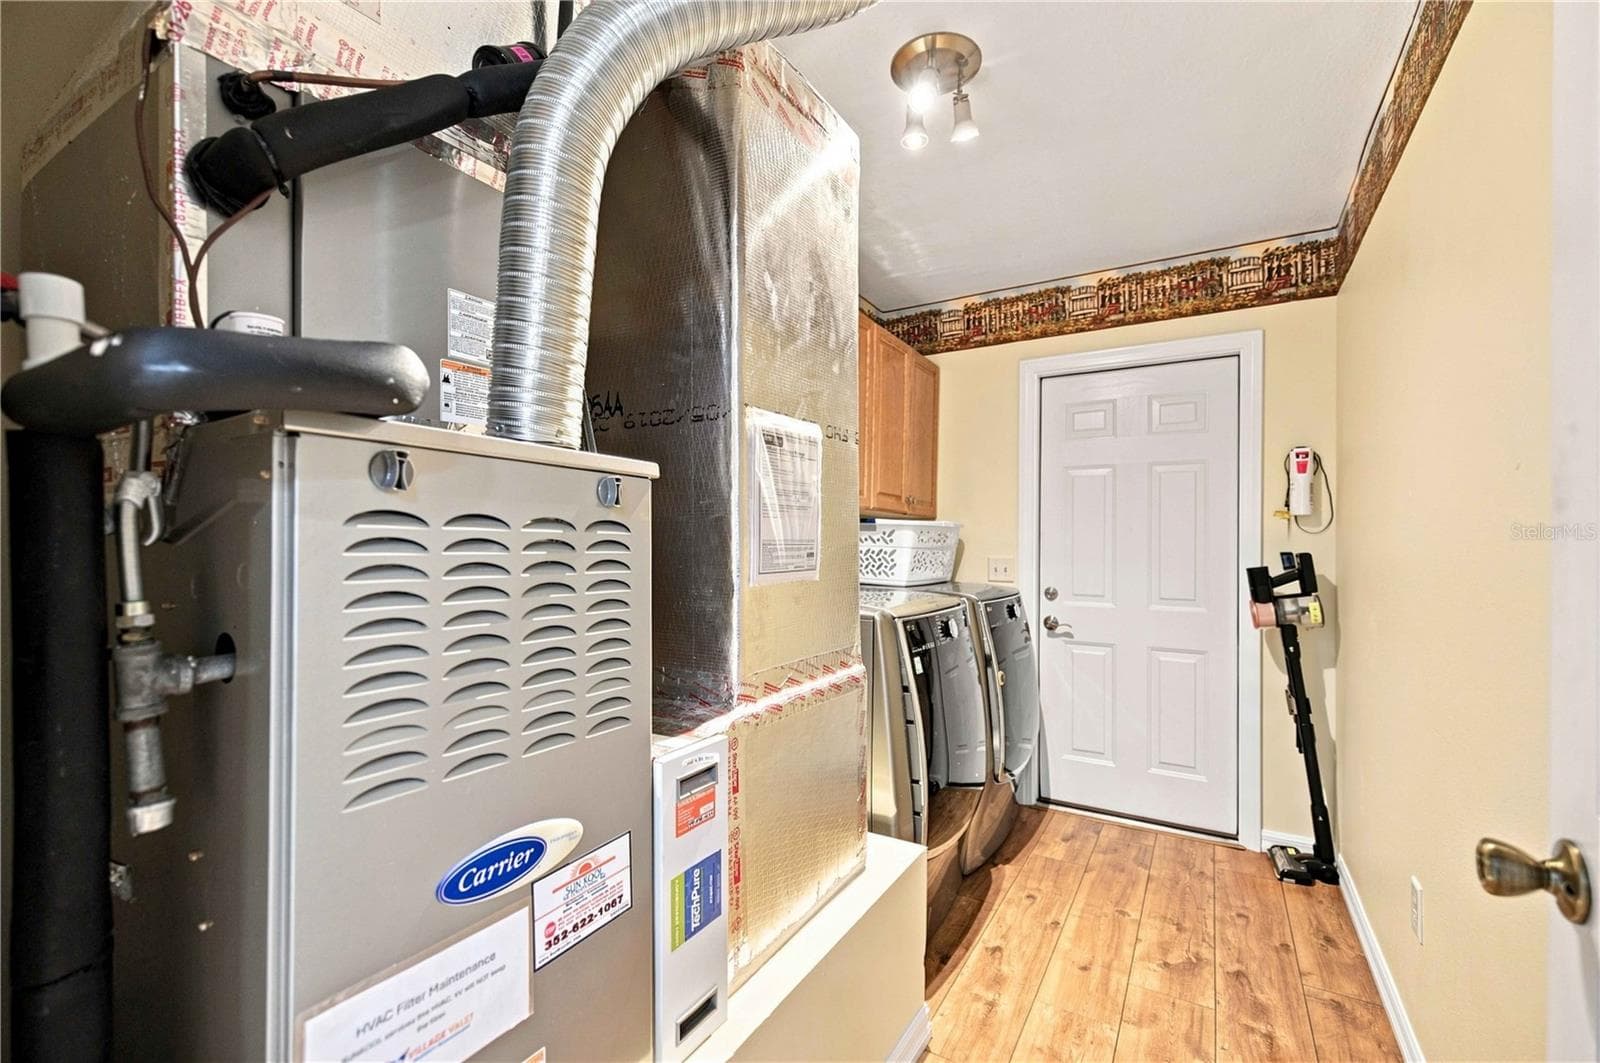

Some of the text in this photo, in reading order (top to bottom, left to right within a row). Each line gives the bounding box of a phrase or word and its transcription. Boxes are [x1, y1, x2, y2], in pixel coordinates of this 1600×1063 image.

[458, 847, 534, 893] Carrier
[691, 868, 701, 932] TechPure
[544, 894, 624, 951] 352-622-1067
[356, 952, 496, 1038] HVAC Filter Maintenance
